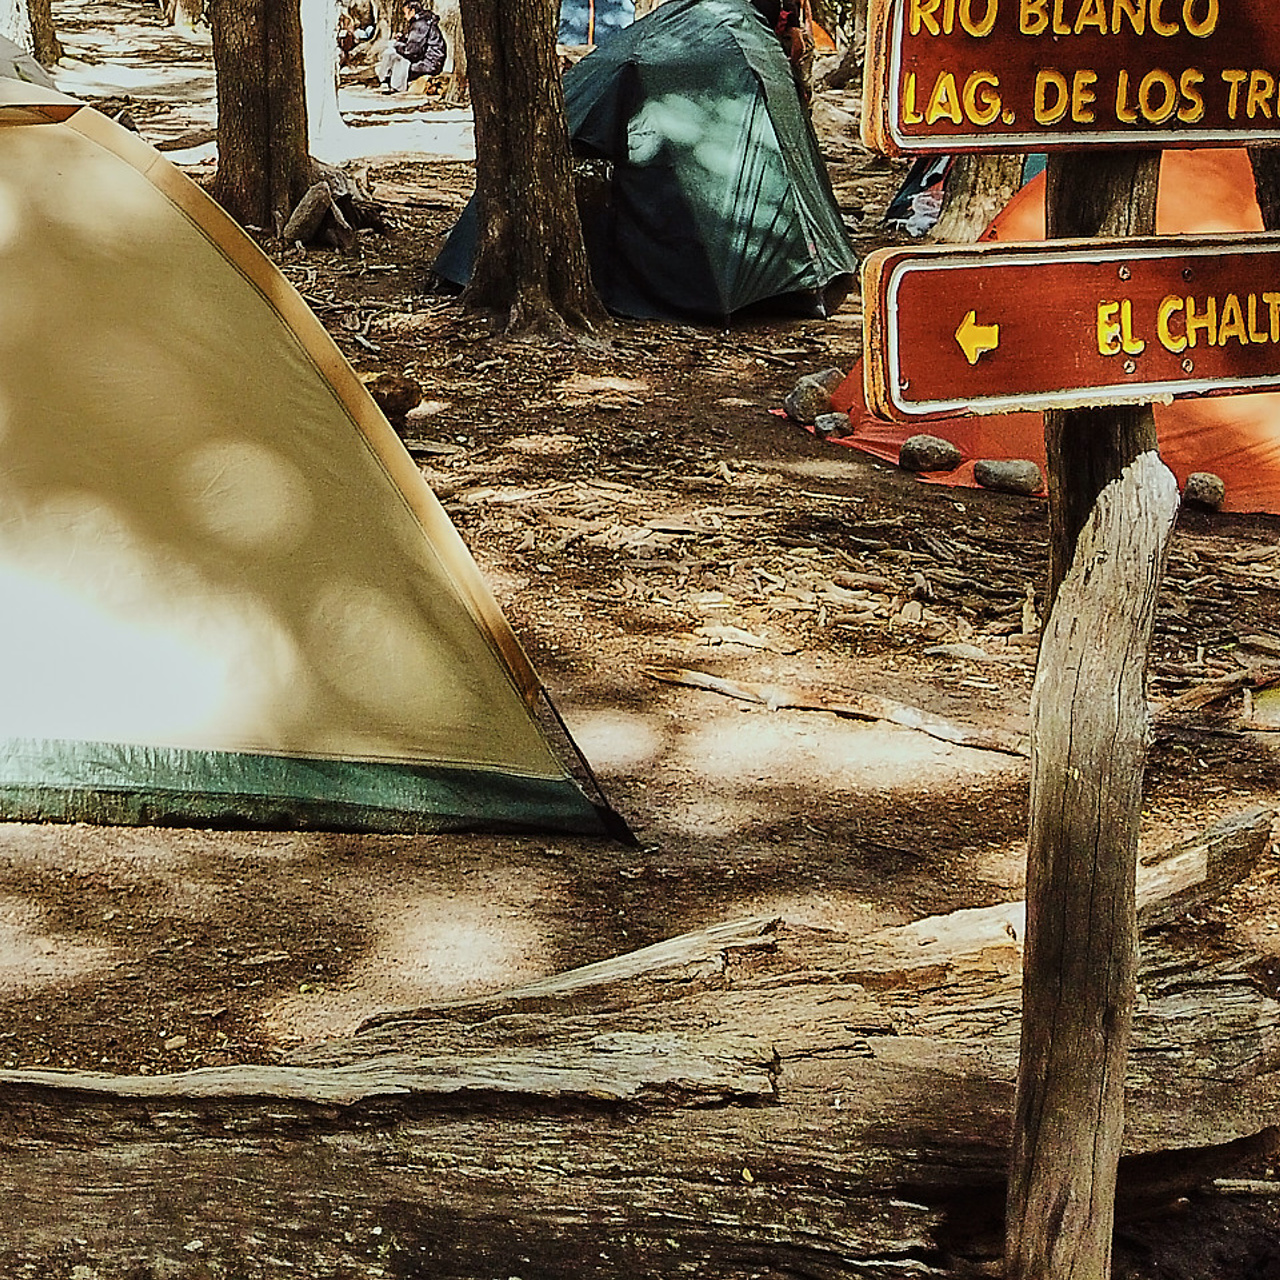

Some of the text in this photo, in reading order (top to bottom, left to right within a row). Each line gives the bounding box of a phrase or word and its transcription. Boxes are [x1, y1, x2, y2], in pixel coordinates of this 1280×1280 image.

[902, 68, 1280, 125] LAG. DE LOS TR
[1096, 292, 1280, 356] EL CHALT
